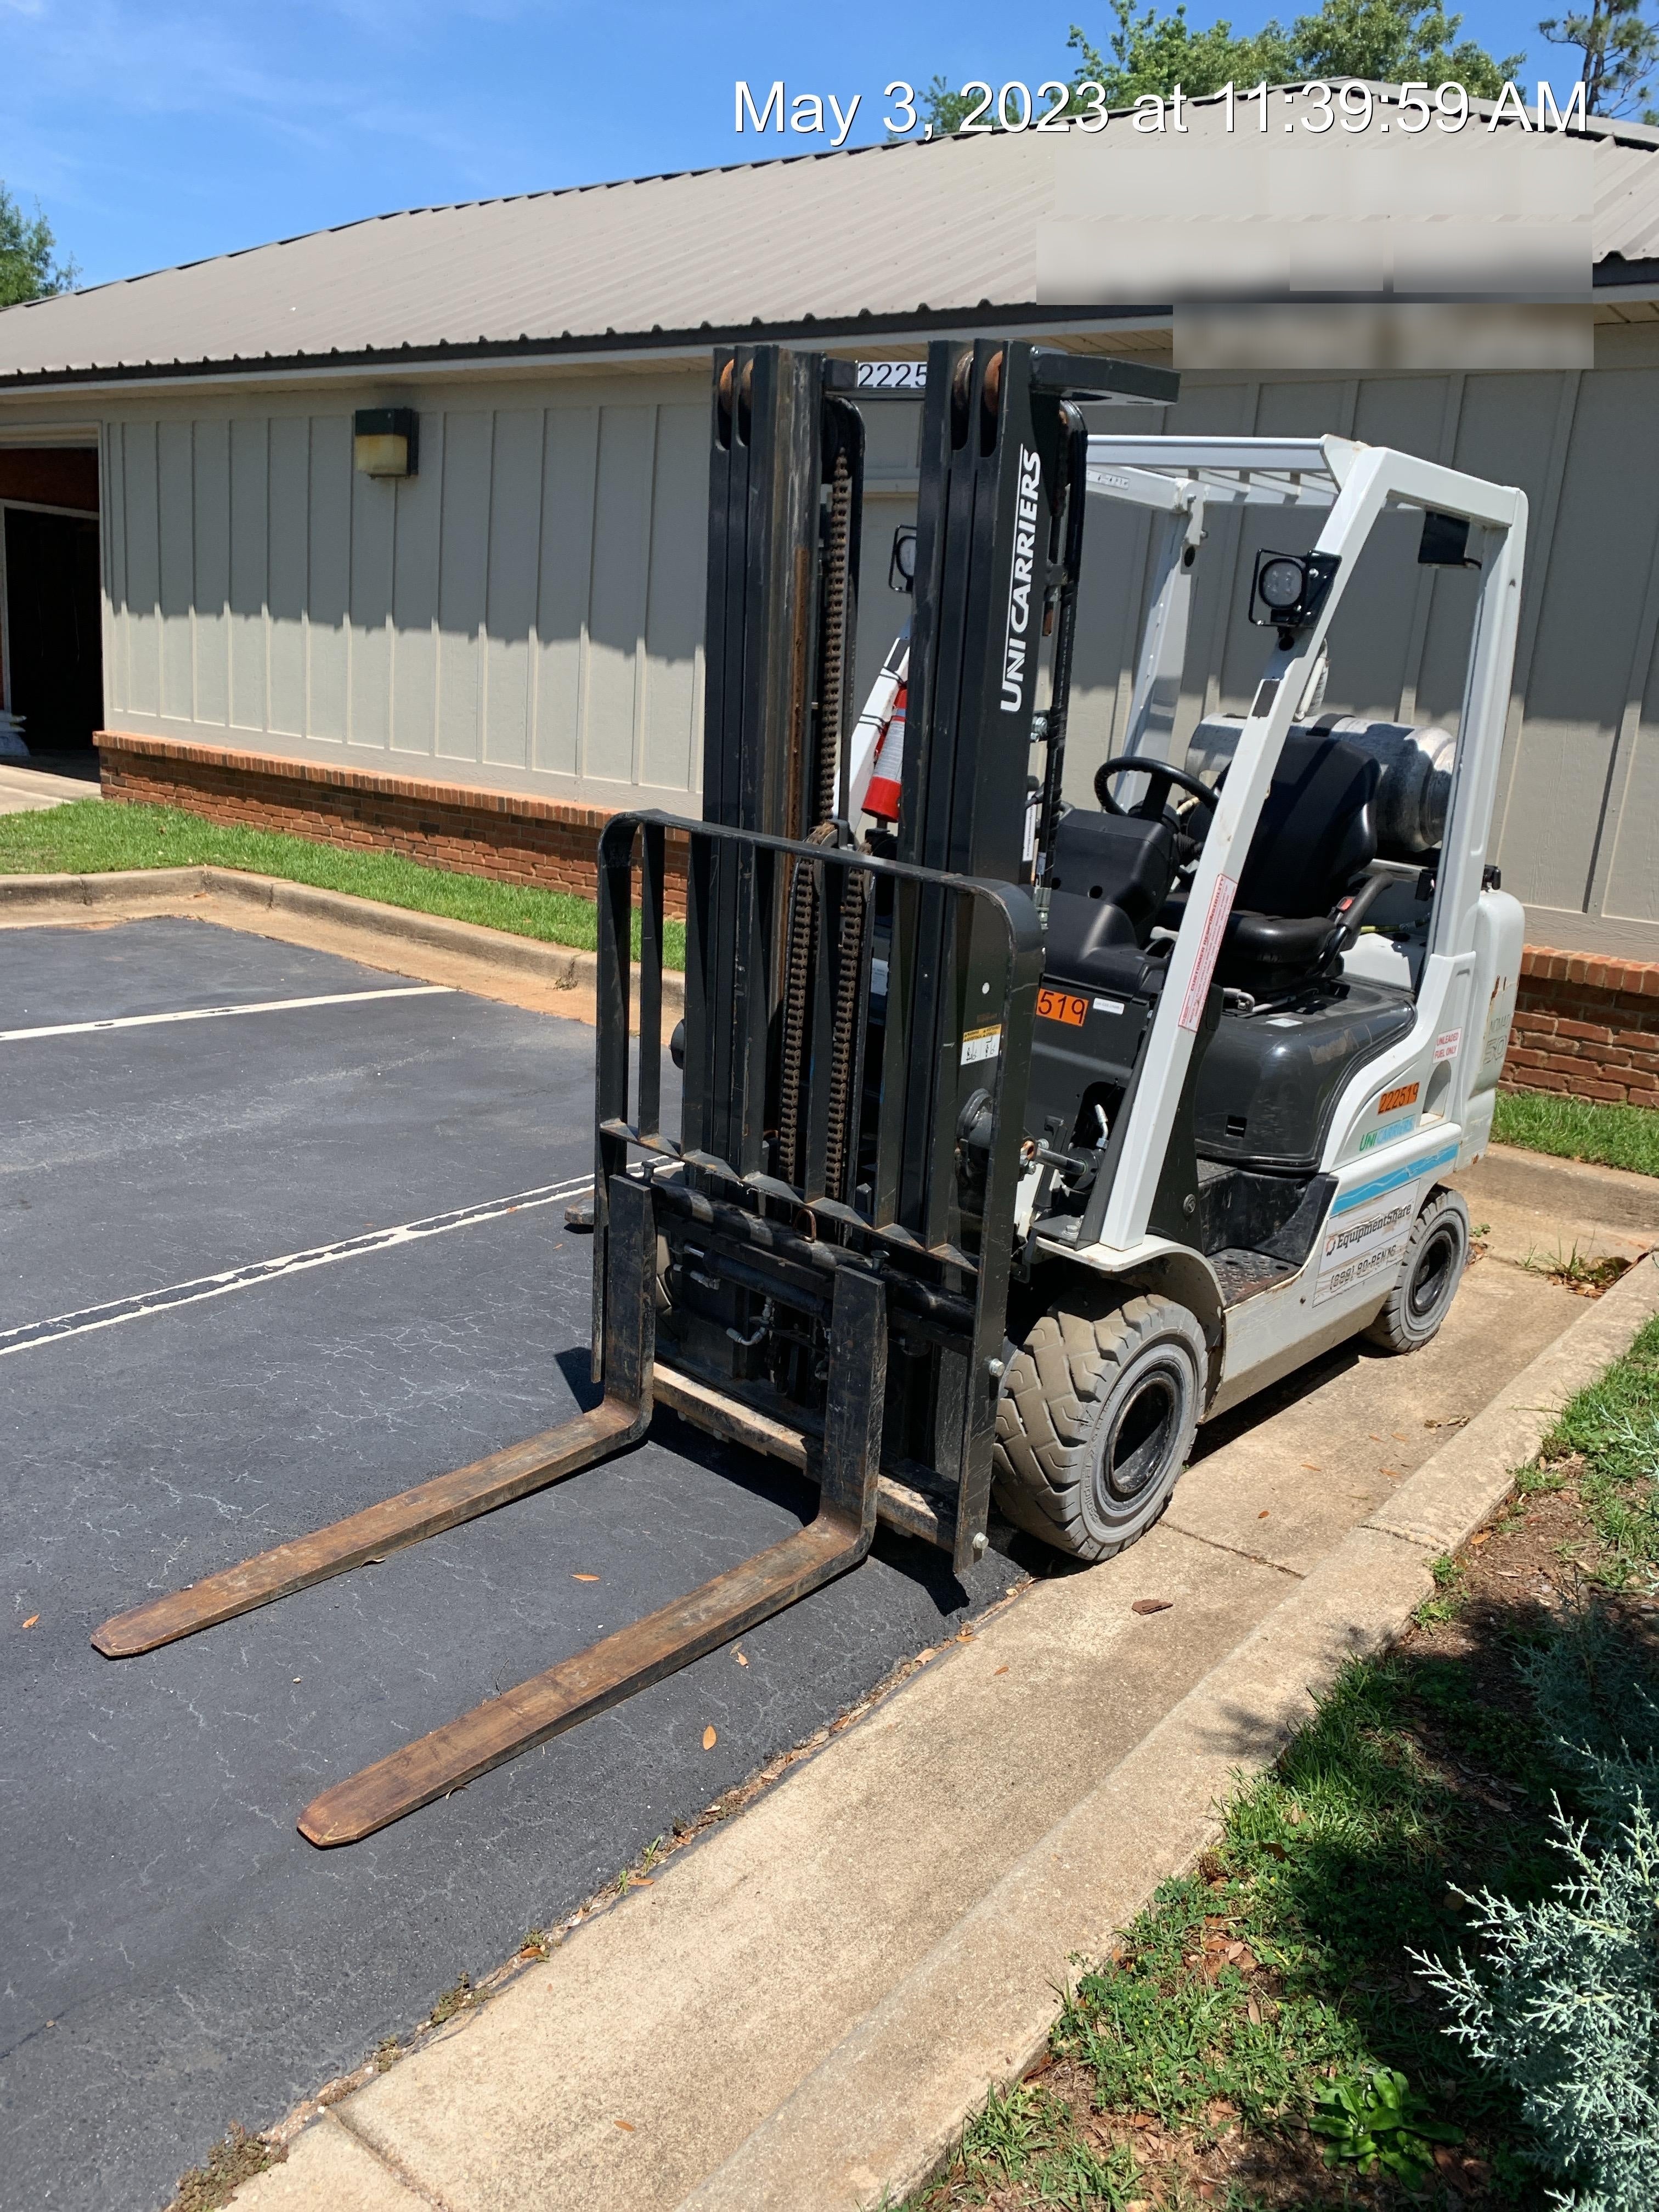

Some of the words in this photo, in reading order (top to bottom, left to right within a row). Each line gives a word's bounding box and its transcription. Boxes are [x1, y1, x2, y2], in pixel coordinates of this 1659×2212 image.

[859, 363, 926, 387] 2225
[1190, 950, 1205, 992] CUSTOMER
[1038, 991, 1085, 1024] 519
[1434, 1049, 1446, 1059] FUEL
[1446, 1045, 1458, 1057] ONLY
[1436, 1032, 1459, 1046] UNLEADED
[1378, 1082, 1420, 1114] 222519
[1336, 1203, 1412, 1249] EquipmentShare
